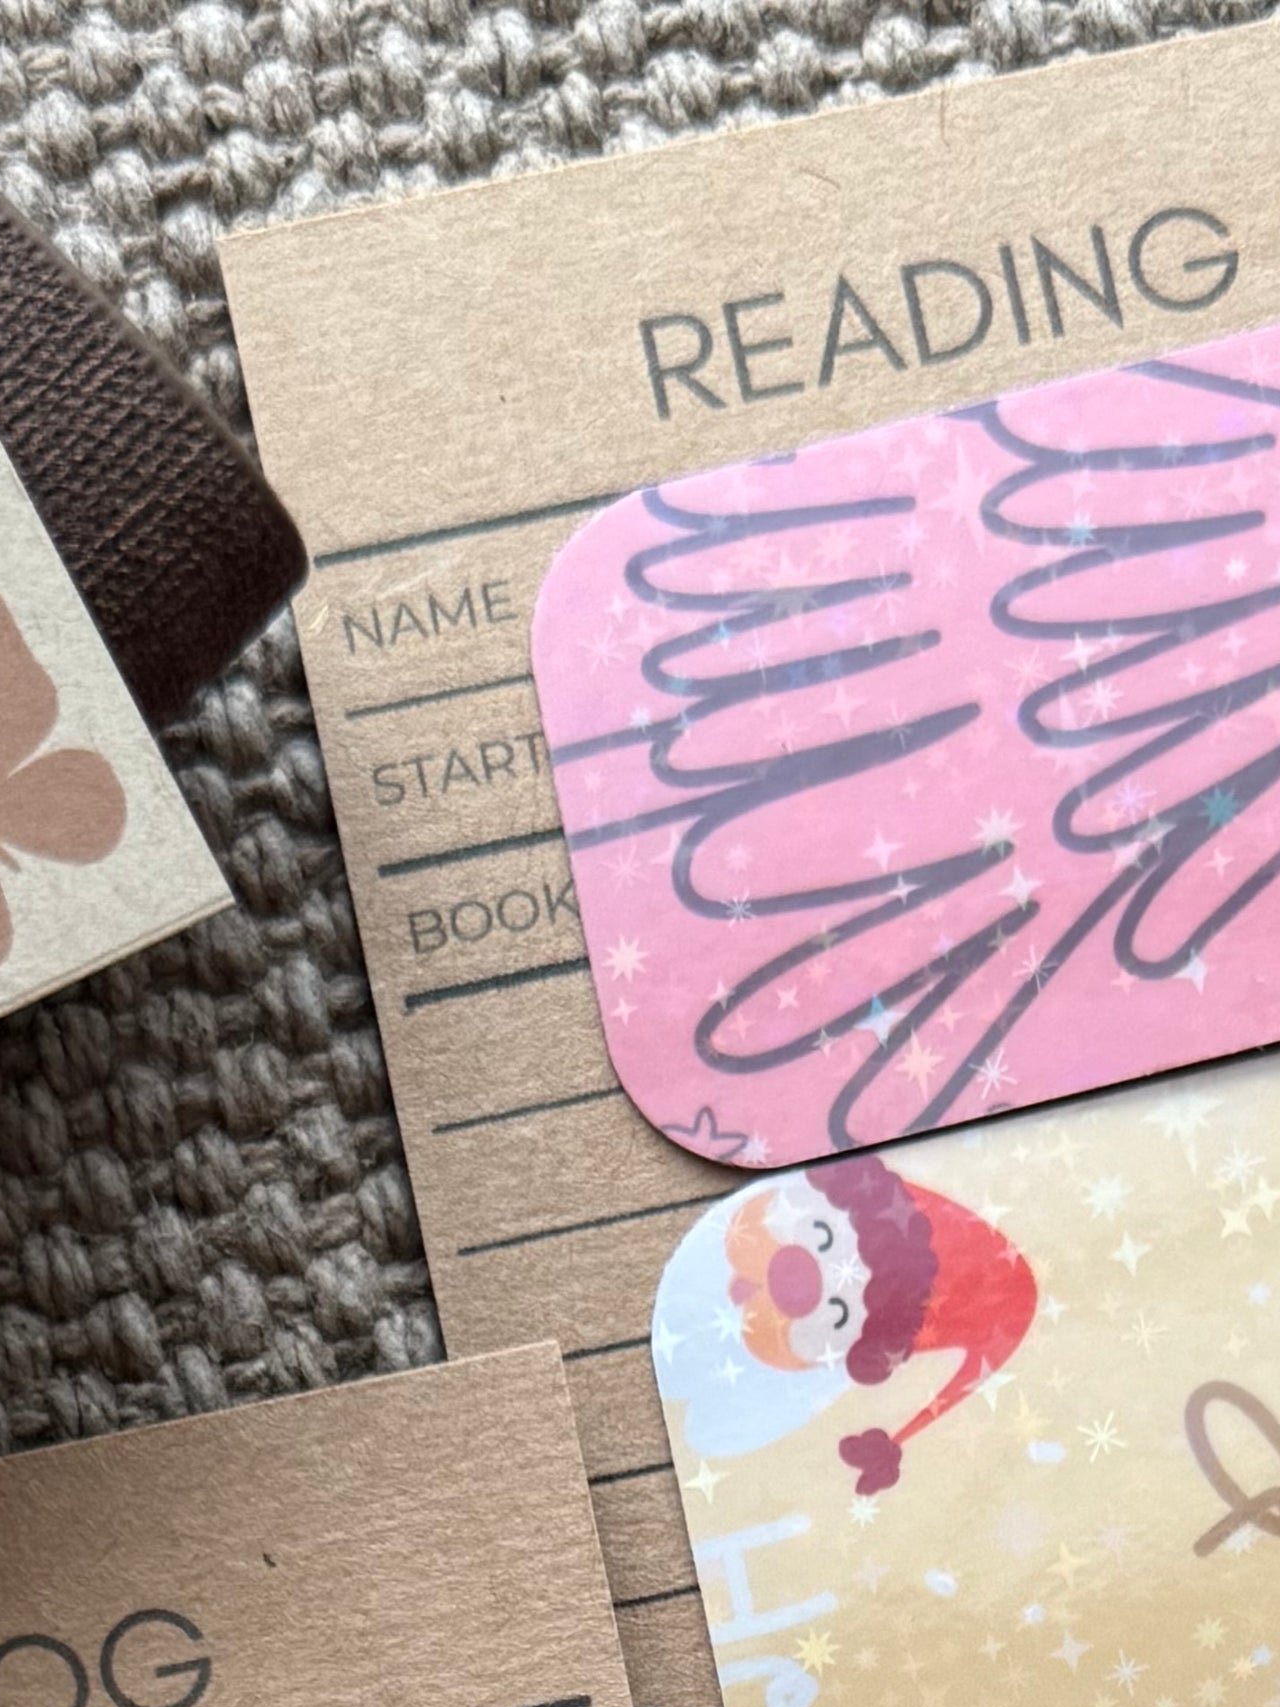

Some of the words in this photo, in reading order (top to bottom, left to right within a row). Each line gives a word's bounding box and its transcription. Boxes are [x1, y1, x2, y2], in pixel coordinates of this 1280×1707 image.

[639, 207, 1240, 422] READING
[341, 580, 519, 655] NAME
[372, 732, 549, 807] START
[407, 879, 580, 955] BOOK
